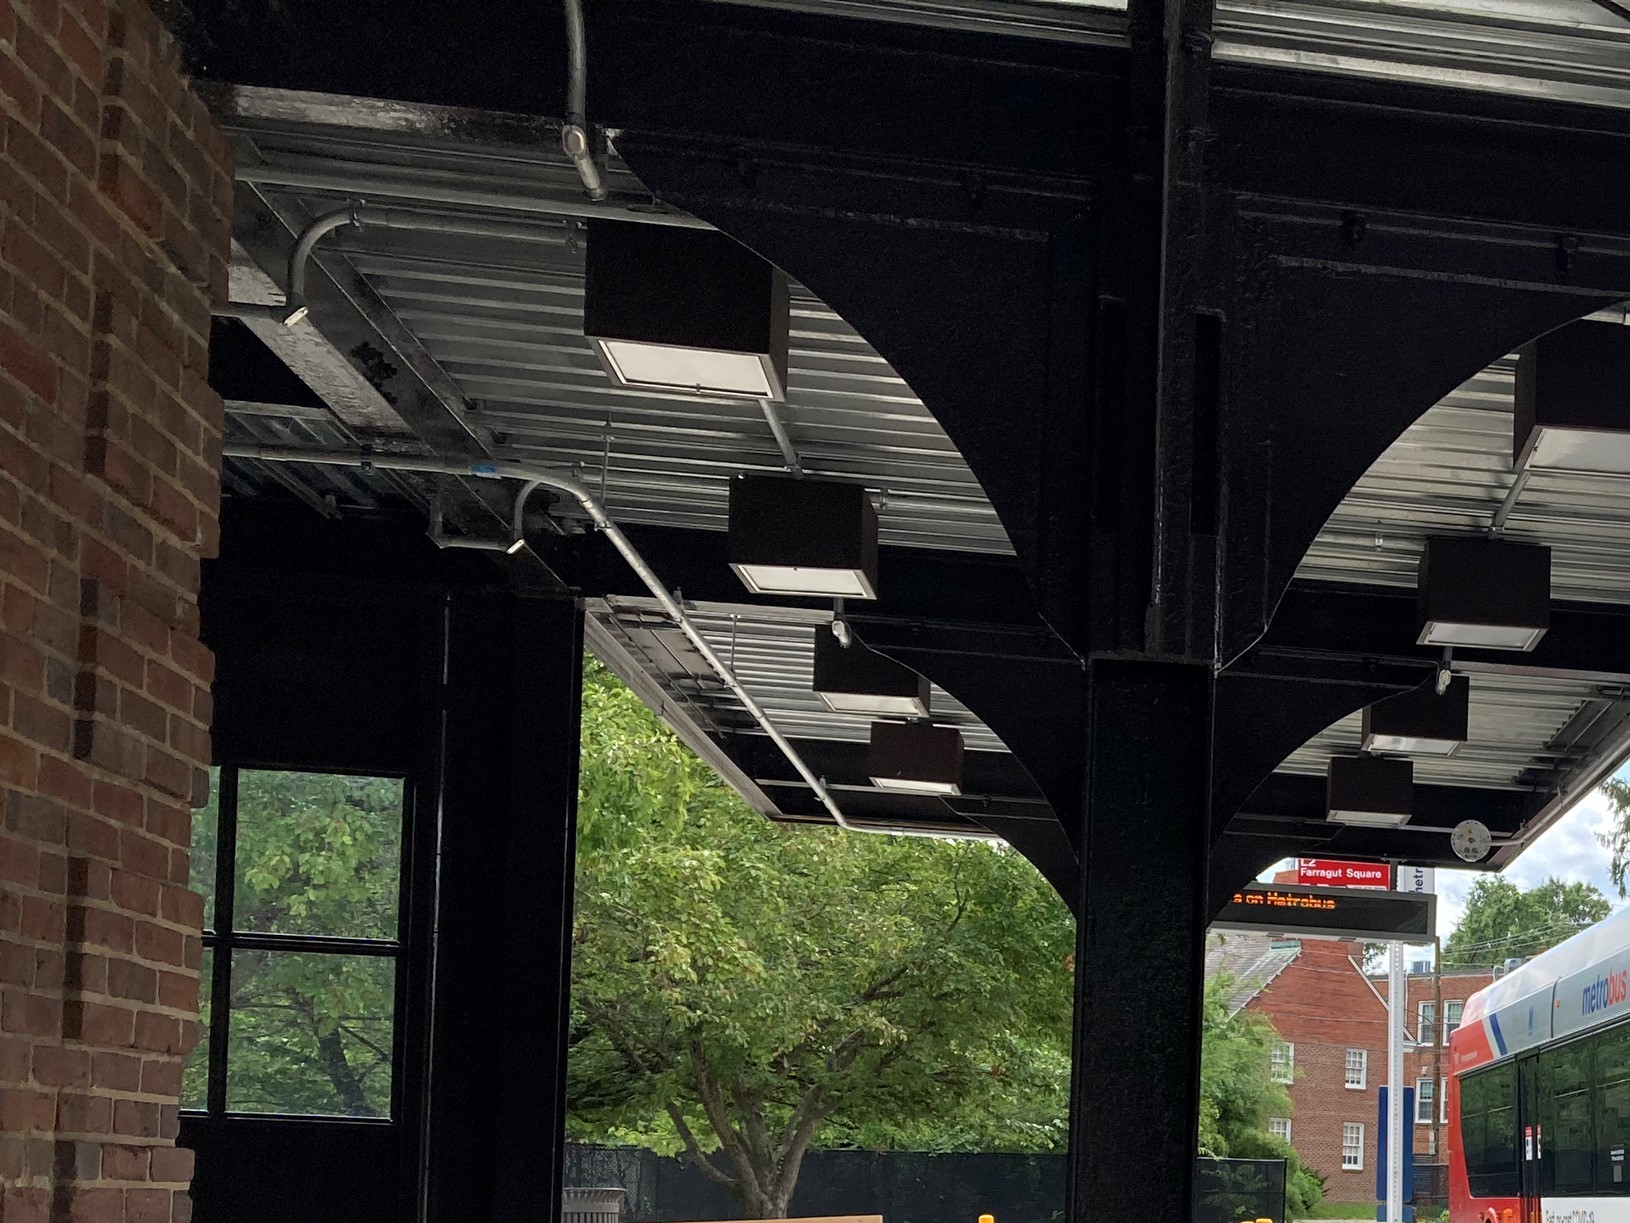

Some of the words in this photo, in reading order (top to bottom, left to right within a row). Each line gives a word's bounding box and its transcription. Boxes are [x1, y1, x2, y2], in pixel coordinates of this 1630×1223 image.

[1300, 867, 1342, 878] Farragut
[1346, 869, 1382, 880] Square
[1582, 968, 1628, 1016] metrobus
